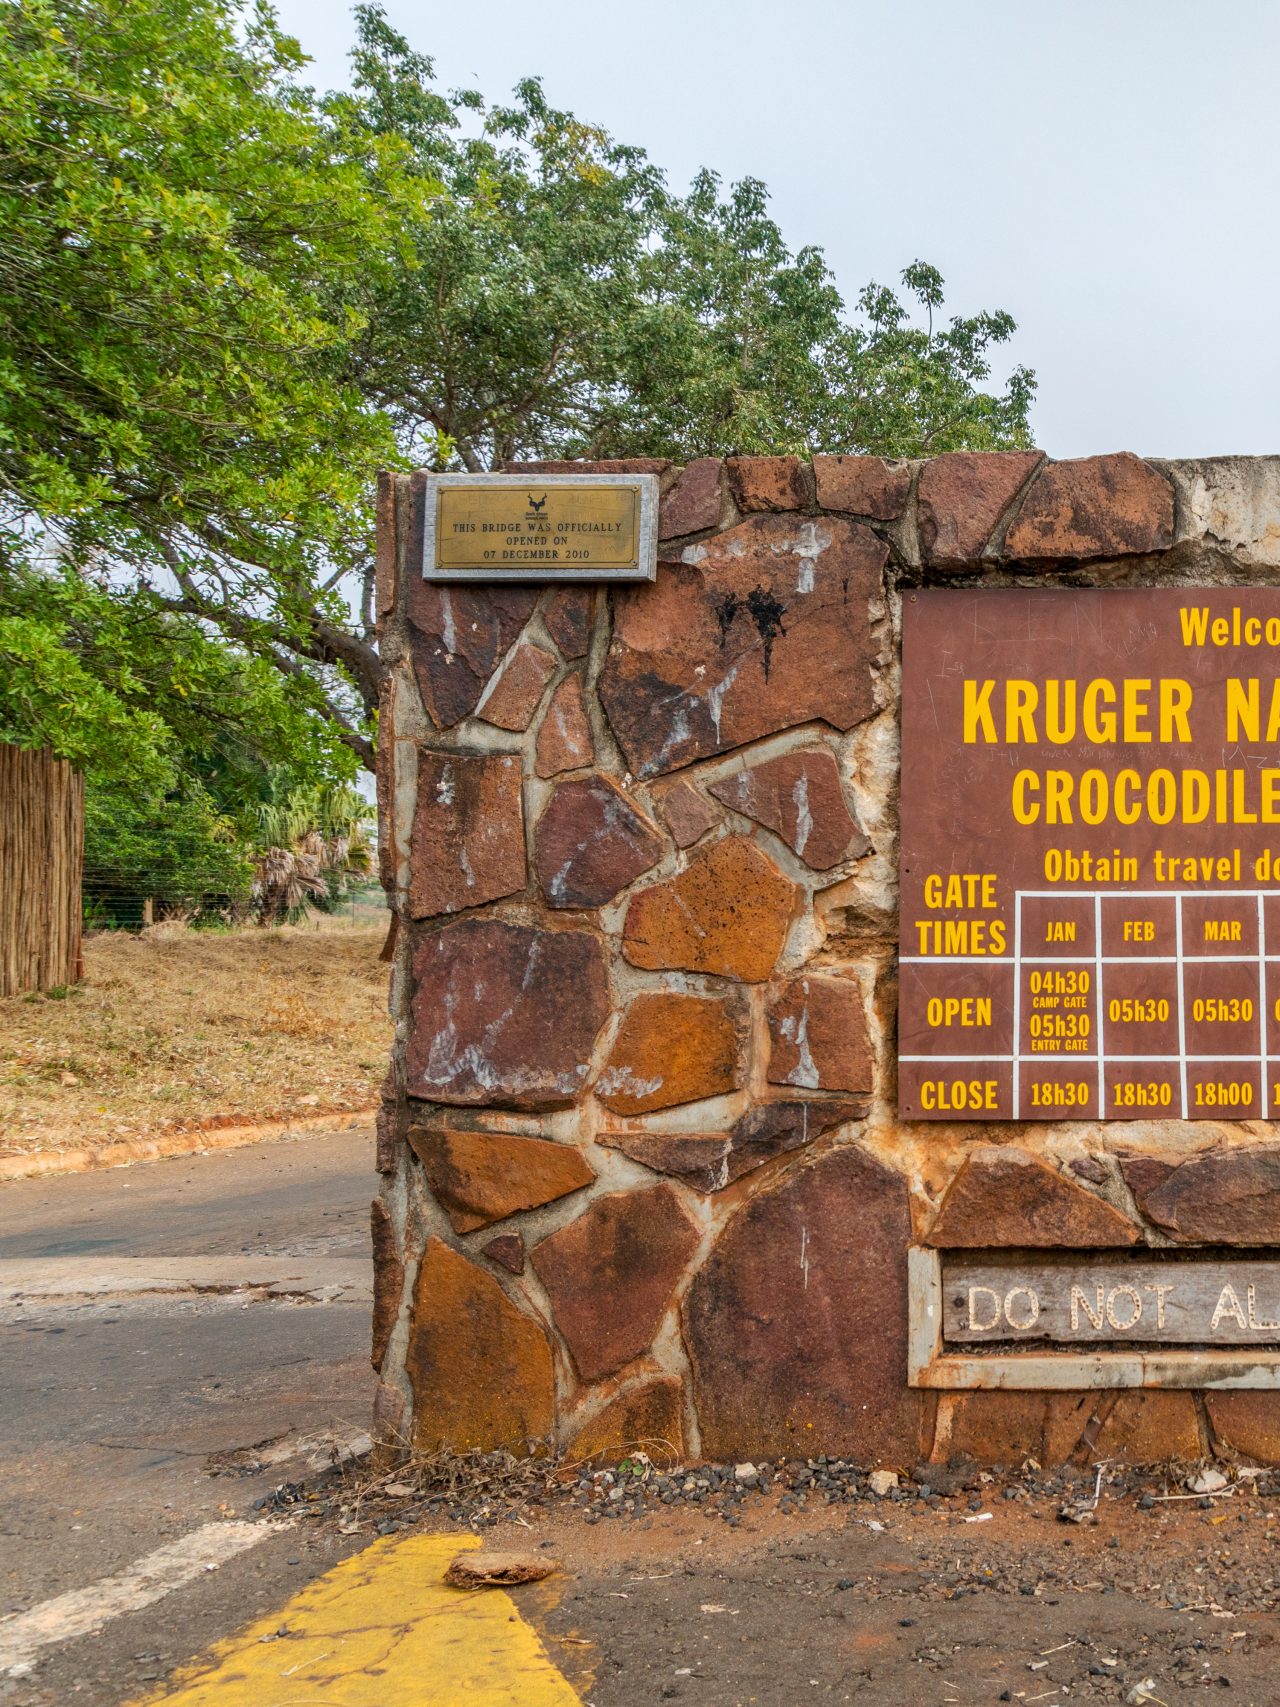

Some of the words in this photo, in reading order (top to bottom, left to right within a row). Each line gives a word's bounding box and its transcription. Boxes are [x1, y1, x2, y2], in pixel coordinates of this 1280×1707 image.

[453, 523, 476, 532] THIS
[482, 523, 521, 532] BRIDGE
[528, 523, 551, 532] WAS
[557, 523, 622, 532] OFFICIALLY
[506, 536, 547, 545] OPENED
[553, 536, 568, 545] ON
[483, 550, 496, 559] 07
[502, 550, 559, 559] DECEMBER
[565, 550, 590, 559] 2010
[962, 677, 1194, 745] KRUGER
[1043, 848, 1139, 883] Obtain
[1153, 848, 1242, 882] travel
[924, 873, 999, 910] GATE
[915, 919, 1007, 957] TIMES
[1046, 922, 1076, 942] JAN
[1123, 921, 1155, 942] FEB
[1204, 920, 1242, 941] MAR
[1030, 971, 1090, 995] 04h30
[927, 997, 993, 1028] OPEN
[1032, 996, 1060, 1009] CAMP
[1064, 996, 1087, 1008] GATE
[1109, 999, 1170, 1023] 05h30
[1192, 999, 1253, 1022] 05h30
[1030, 1014, 1090, 1038] 05h30
[1031, 1039, 1061, 1052] ENTRY
[1065, 1039, 1088, 1051] GATE
[920, 1079, 998, 1110] CLOSE
[1031, 1082, 1089, 1107] 18h30
[1114, 1082, 1172, 1107] 18h30
[1195, 1082, 1253, 1106] 18h00
[968, 1285, 1039, 1331] DO
[1071, 1283, 1175, 1330] NOT
